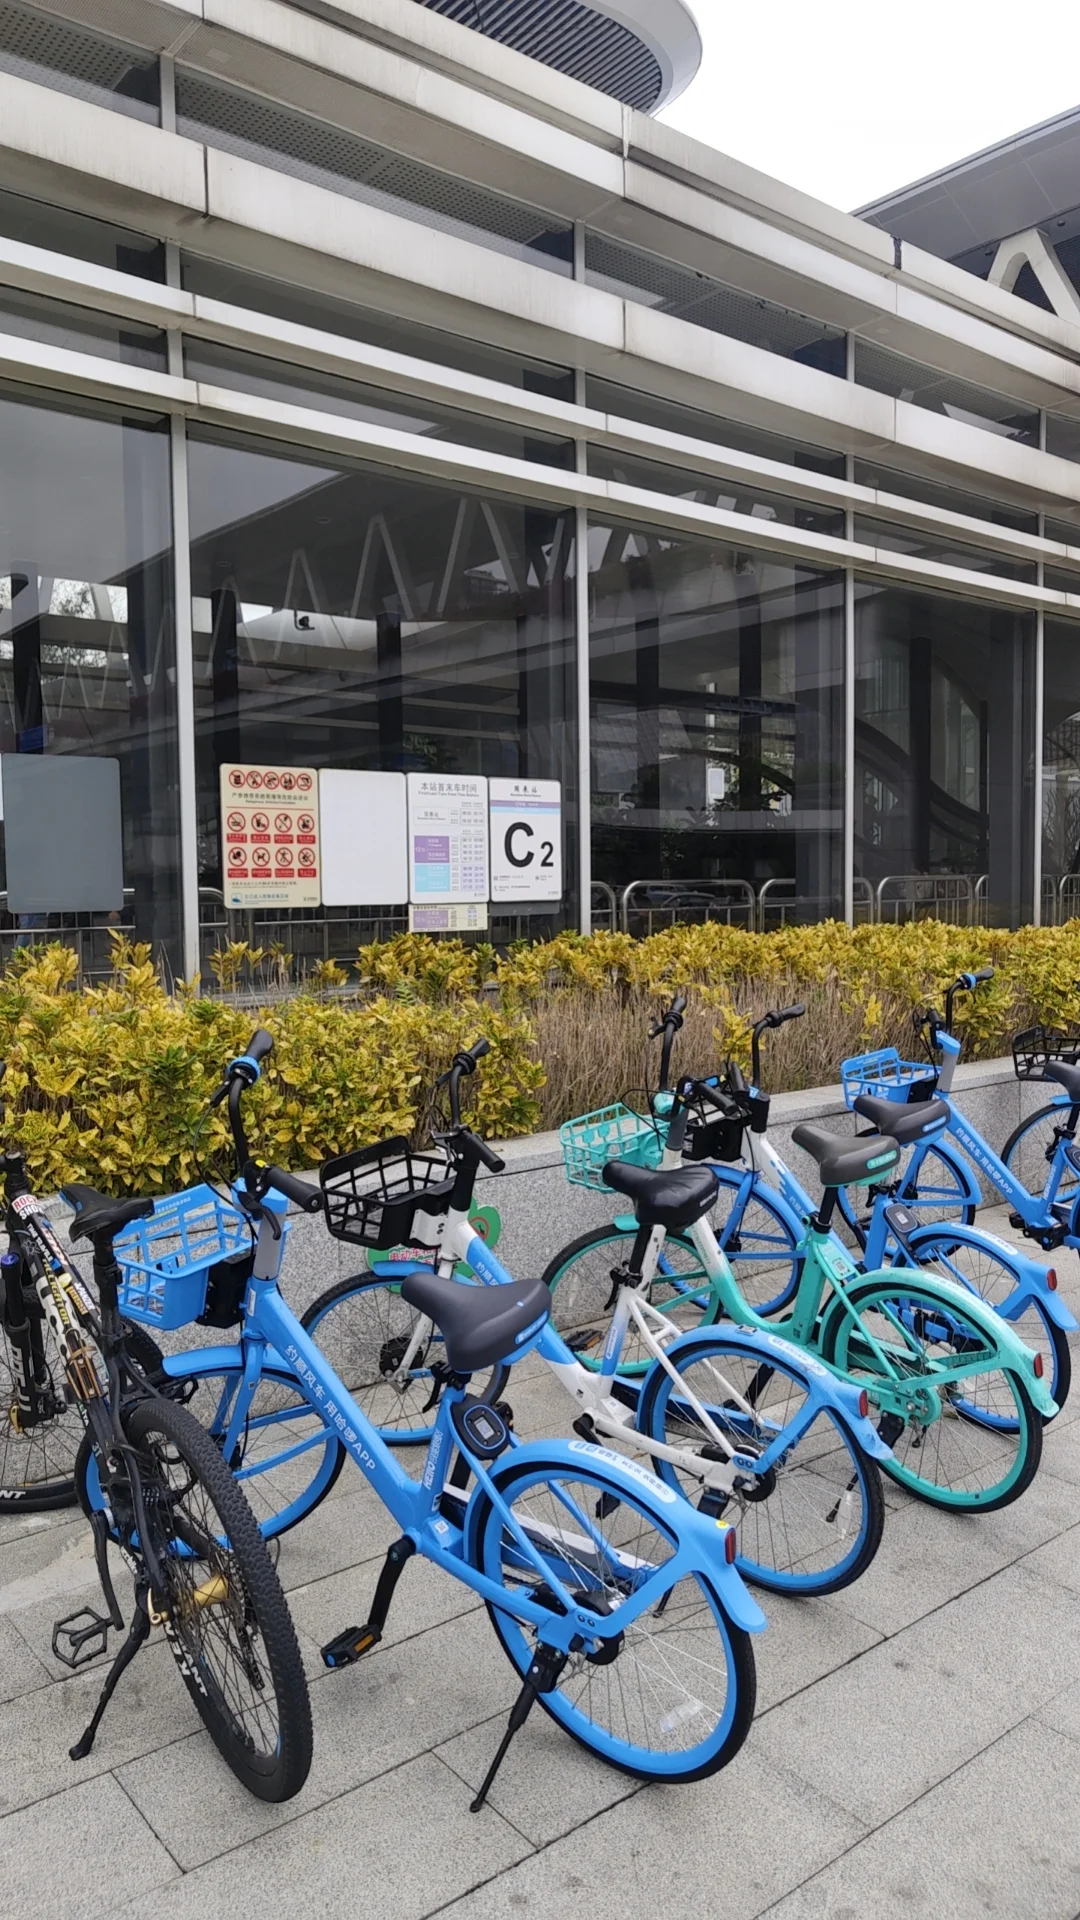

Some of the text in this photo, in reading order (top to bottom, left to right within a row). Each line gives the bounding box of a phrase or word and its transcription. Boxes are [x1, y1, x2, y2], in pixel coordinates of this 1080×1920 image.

[421, 782, 477, 793] 本站首末车时间
[42, 1259, 70, 1325] ALLIGATOR
[284, 1344, 376, 1471] 约顺风车 用哈啰APP
